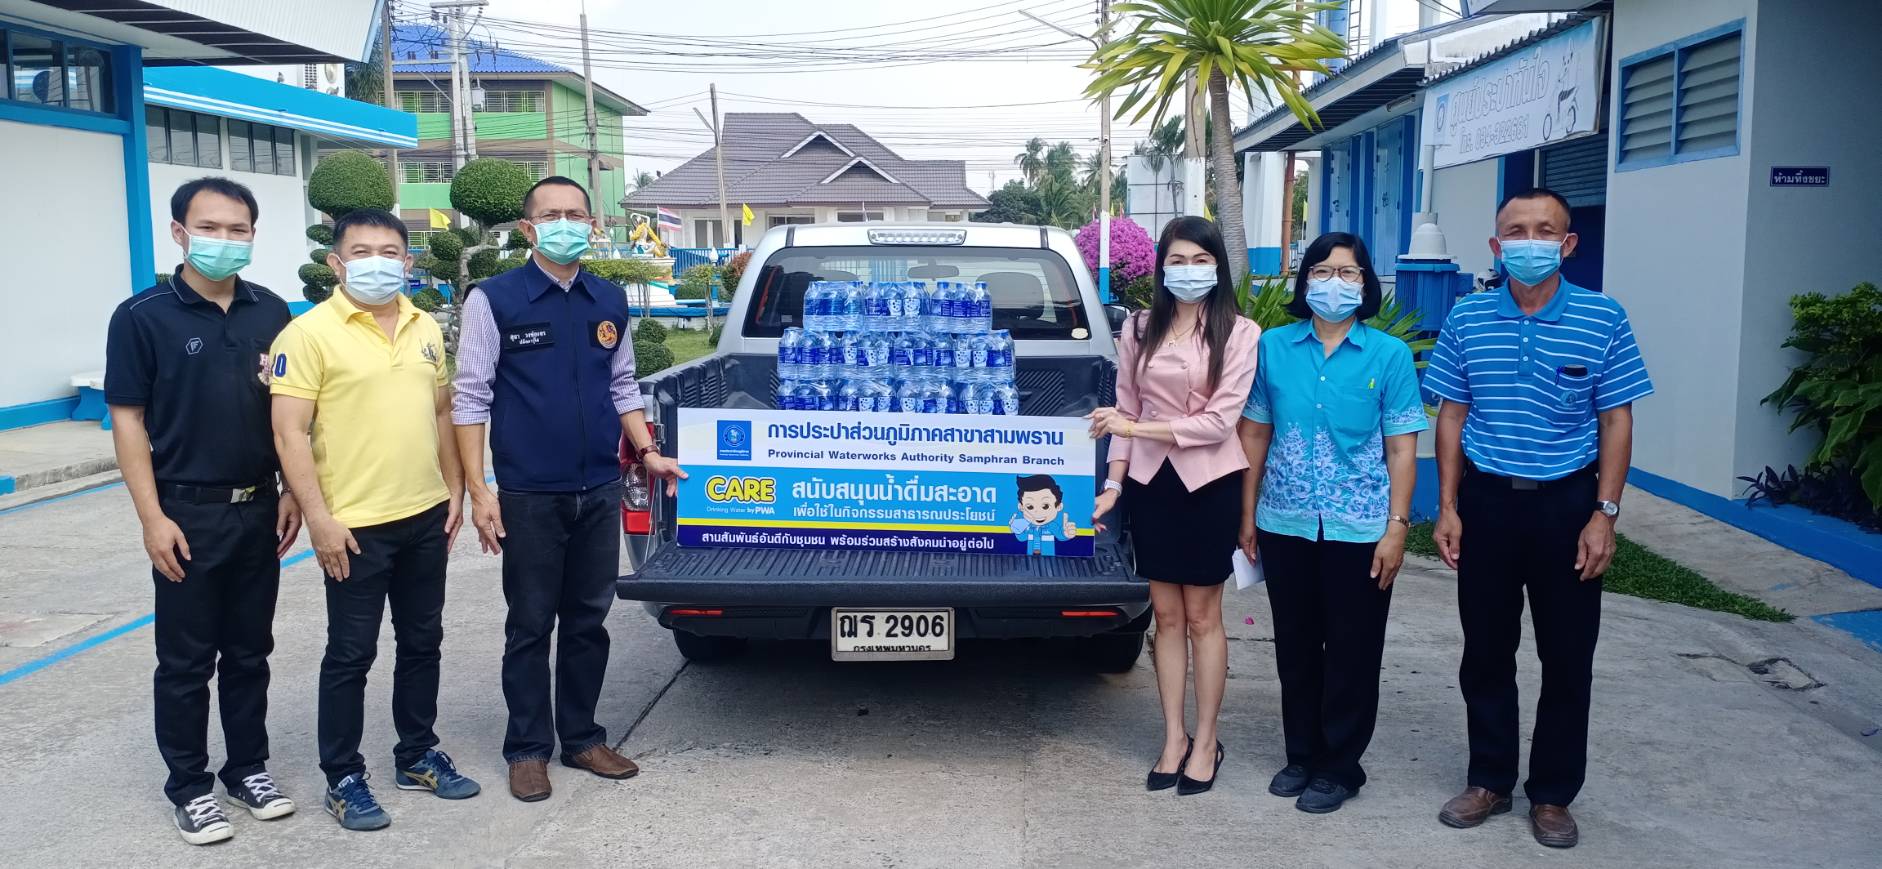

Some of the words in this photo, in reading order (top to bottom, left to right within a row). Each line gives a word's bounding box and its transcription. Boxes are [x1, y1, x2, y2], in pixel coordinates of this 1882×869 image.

[1774, 170, 1825, 183] ห้ามทิ้งขยะ
[769, 421, 1063, 445] การประปาส่วนภูมิภาคสาขาสามพราน
[767, 448, 824, 460] Provincial
[828, 450, 897, 463] Waterworks
[901, 452, 954, 464] Authority
[958, 453, 1018, 465] Samphran
[1022, 455, 1065, 466] Branch
[705, 475, 776, 503] CARE
[793, 474, 996, 505] สนับสนุนน้ำดื่มสะอาด
[755, 506, 776, 515] PWA
[794, 503, 995, 521] เพื่อใช้ในกิจกรรมสาธารณประโยชน์
[702, 532, 825, 547] สานสัมพันธ์อันดีกับชุมชน
[885, 615, 944, 637] 2906
